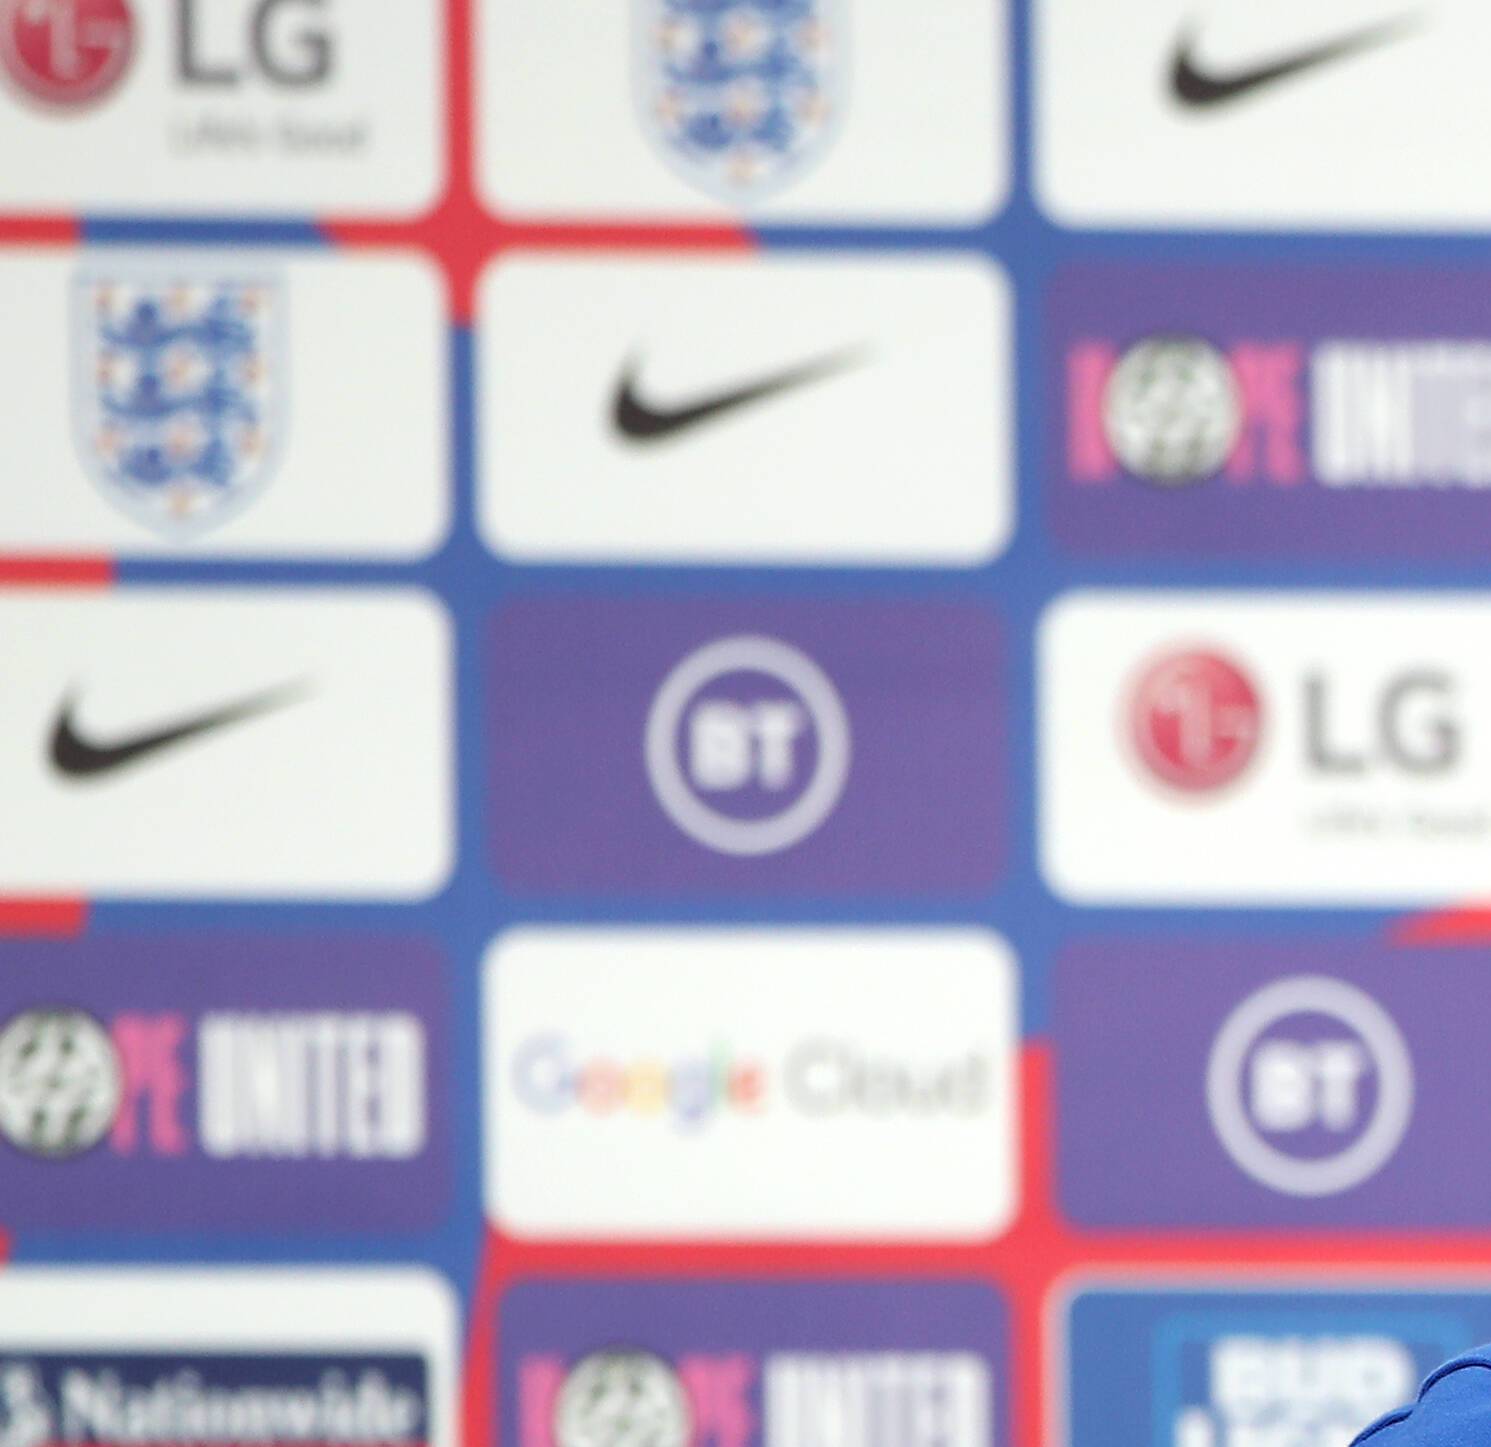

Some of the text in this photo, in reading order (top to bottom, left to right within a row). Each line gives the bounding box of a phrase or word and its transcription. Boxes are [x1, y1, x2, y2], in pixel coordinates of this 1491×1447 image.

[172, 0, 335, 91] LG
[688, 700, 803, 791] BT
[1300, 668, 1465, 779] LG
[199, 1012, 427, 1157] UNITED
[511, 1033, 990, 1133] Google Cloud
[1249, 1039, 1367, 1133] BT
[1211, 1335, 1416, 1408] BUD
